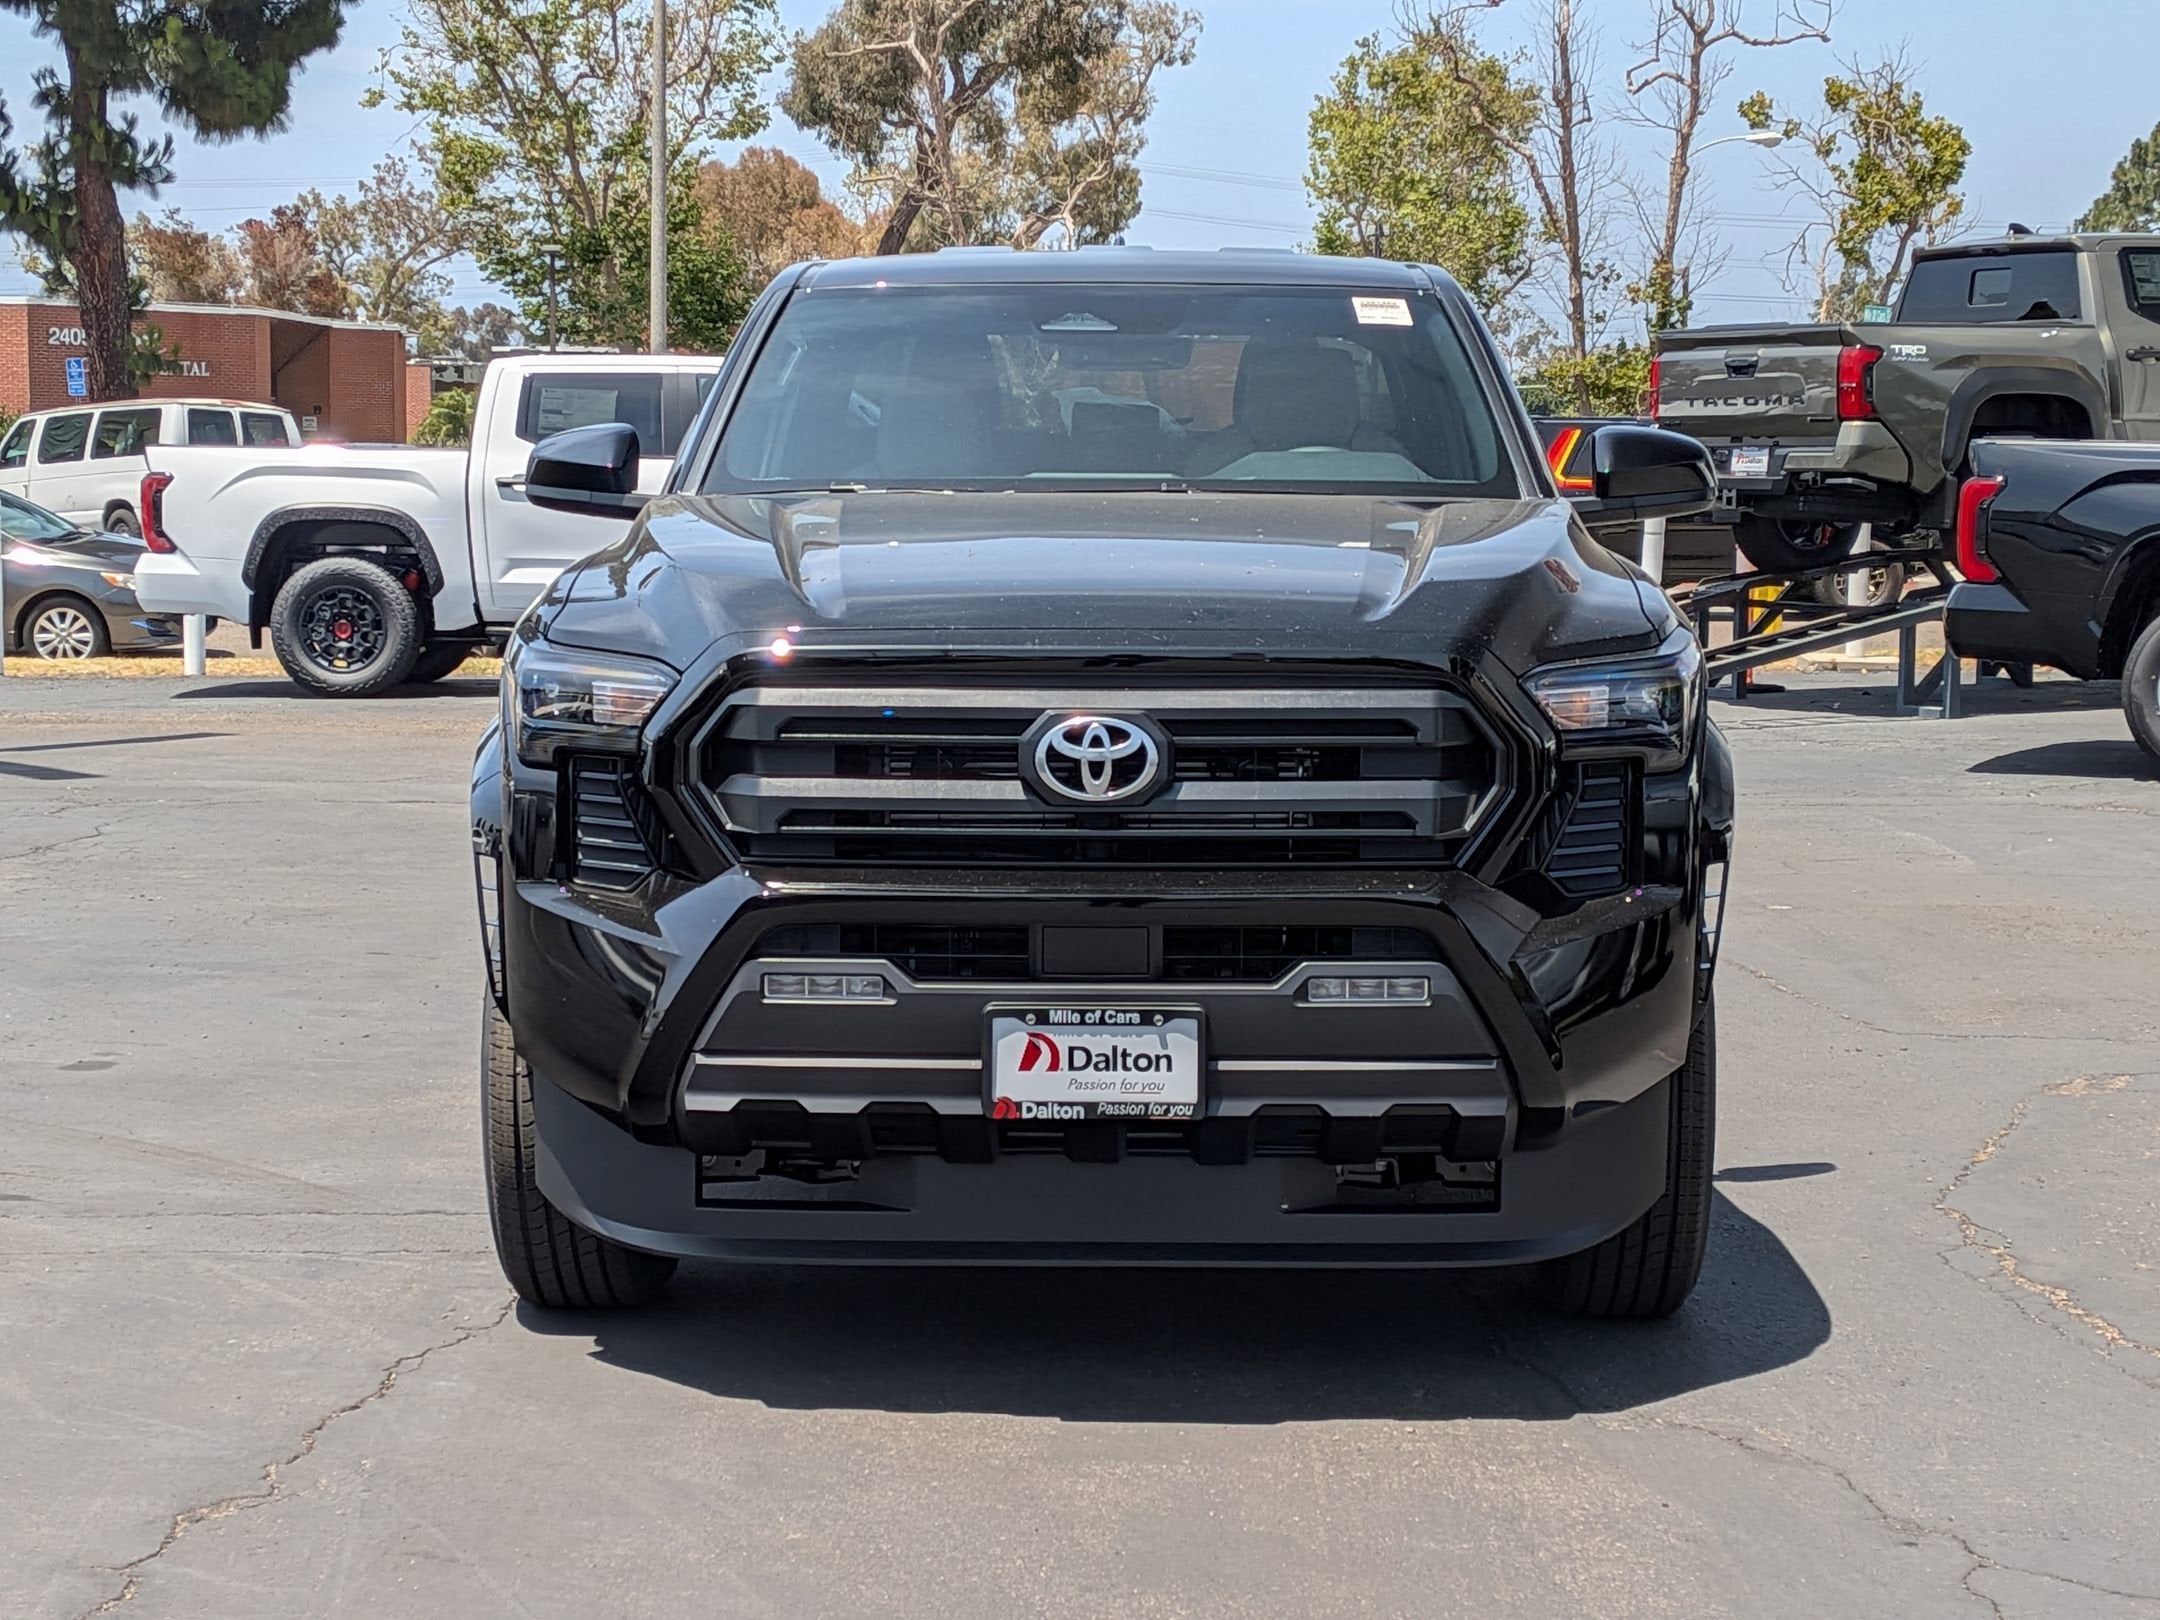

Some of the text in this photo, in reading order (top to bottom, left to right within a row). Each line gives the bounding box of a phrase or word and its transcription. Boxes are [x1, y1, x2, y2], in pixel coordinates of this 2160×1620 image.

[1890, 344, 1927, 356] TRD
[1685, 394, 1806, 408] TACOMA
[1049, 1010, 1141, 1024] Mile of Cars
[1067, 1045, 1173, 1073] Dalton
[1067, 1078, 1165, 1094] Passion for you
[1021, 1102, 1194, 1119] Dalton Passion for you
